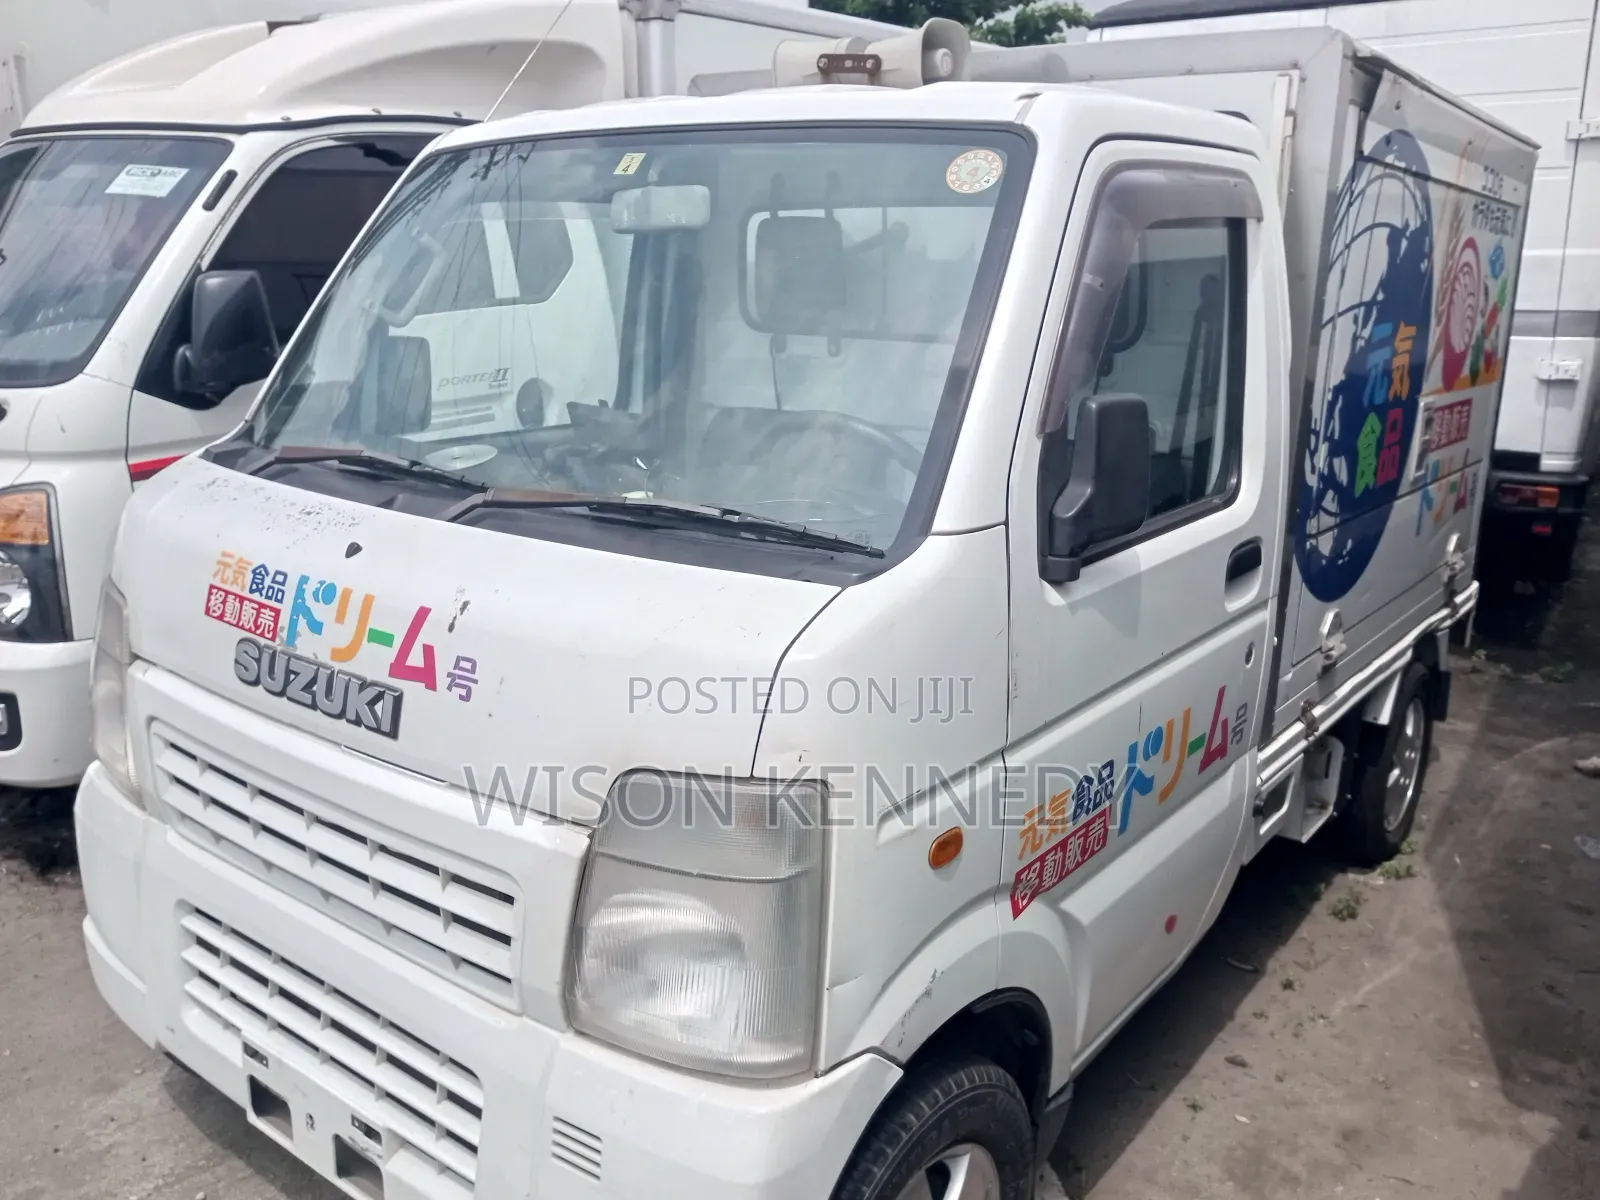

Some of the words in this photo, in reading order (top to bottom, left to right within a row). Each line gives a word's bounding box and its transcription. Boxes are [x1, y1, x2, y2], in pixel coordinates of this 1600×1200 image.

[1362, 320, 1417, 408] 元気
[1354, 411, 1404, 498] 食品
[207, 586, 279, 640] 移動販売
[212, 550, 289, 605] 元気食品
[234, 637, 404, 741] SUZUKI
[1018, 758, 1115, 861] 元気食品
[1012, 813, 1108, 912] 移動販売
